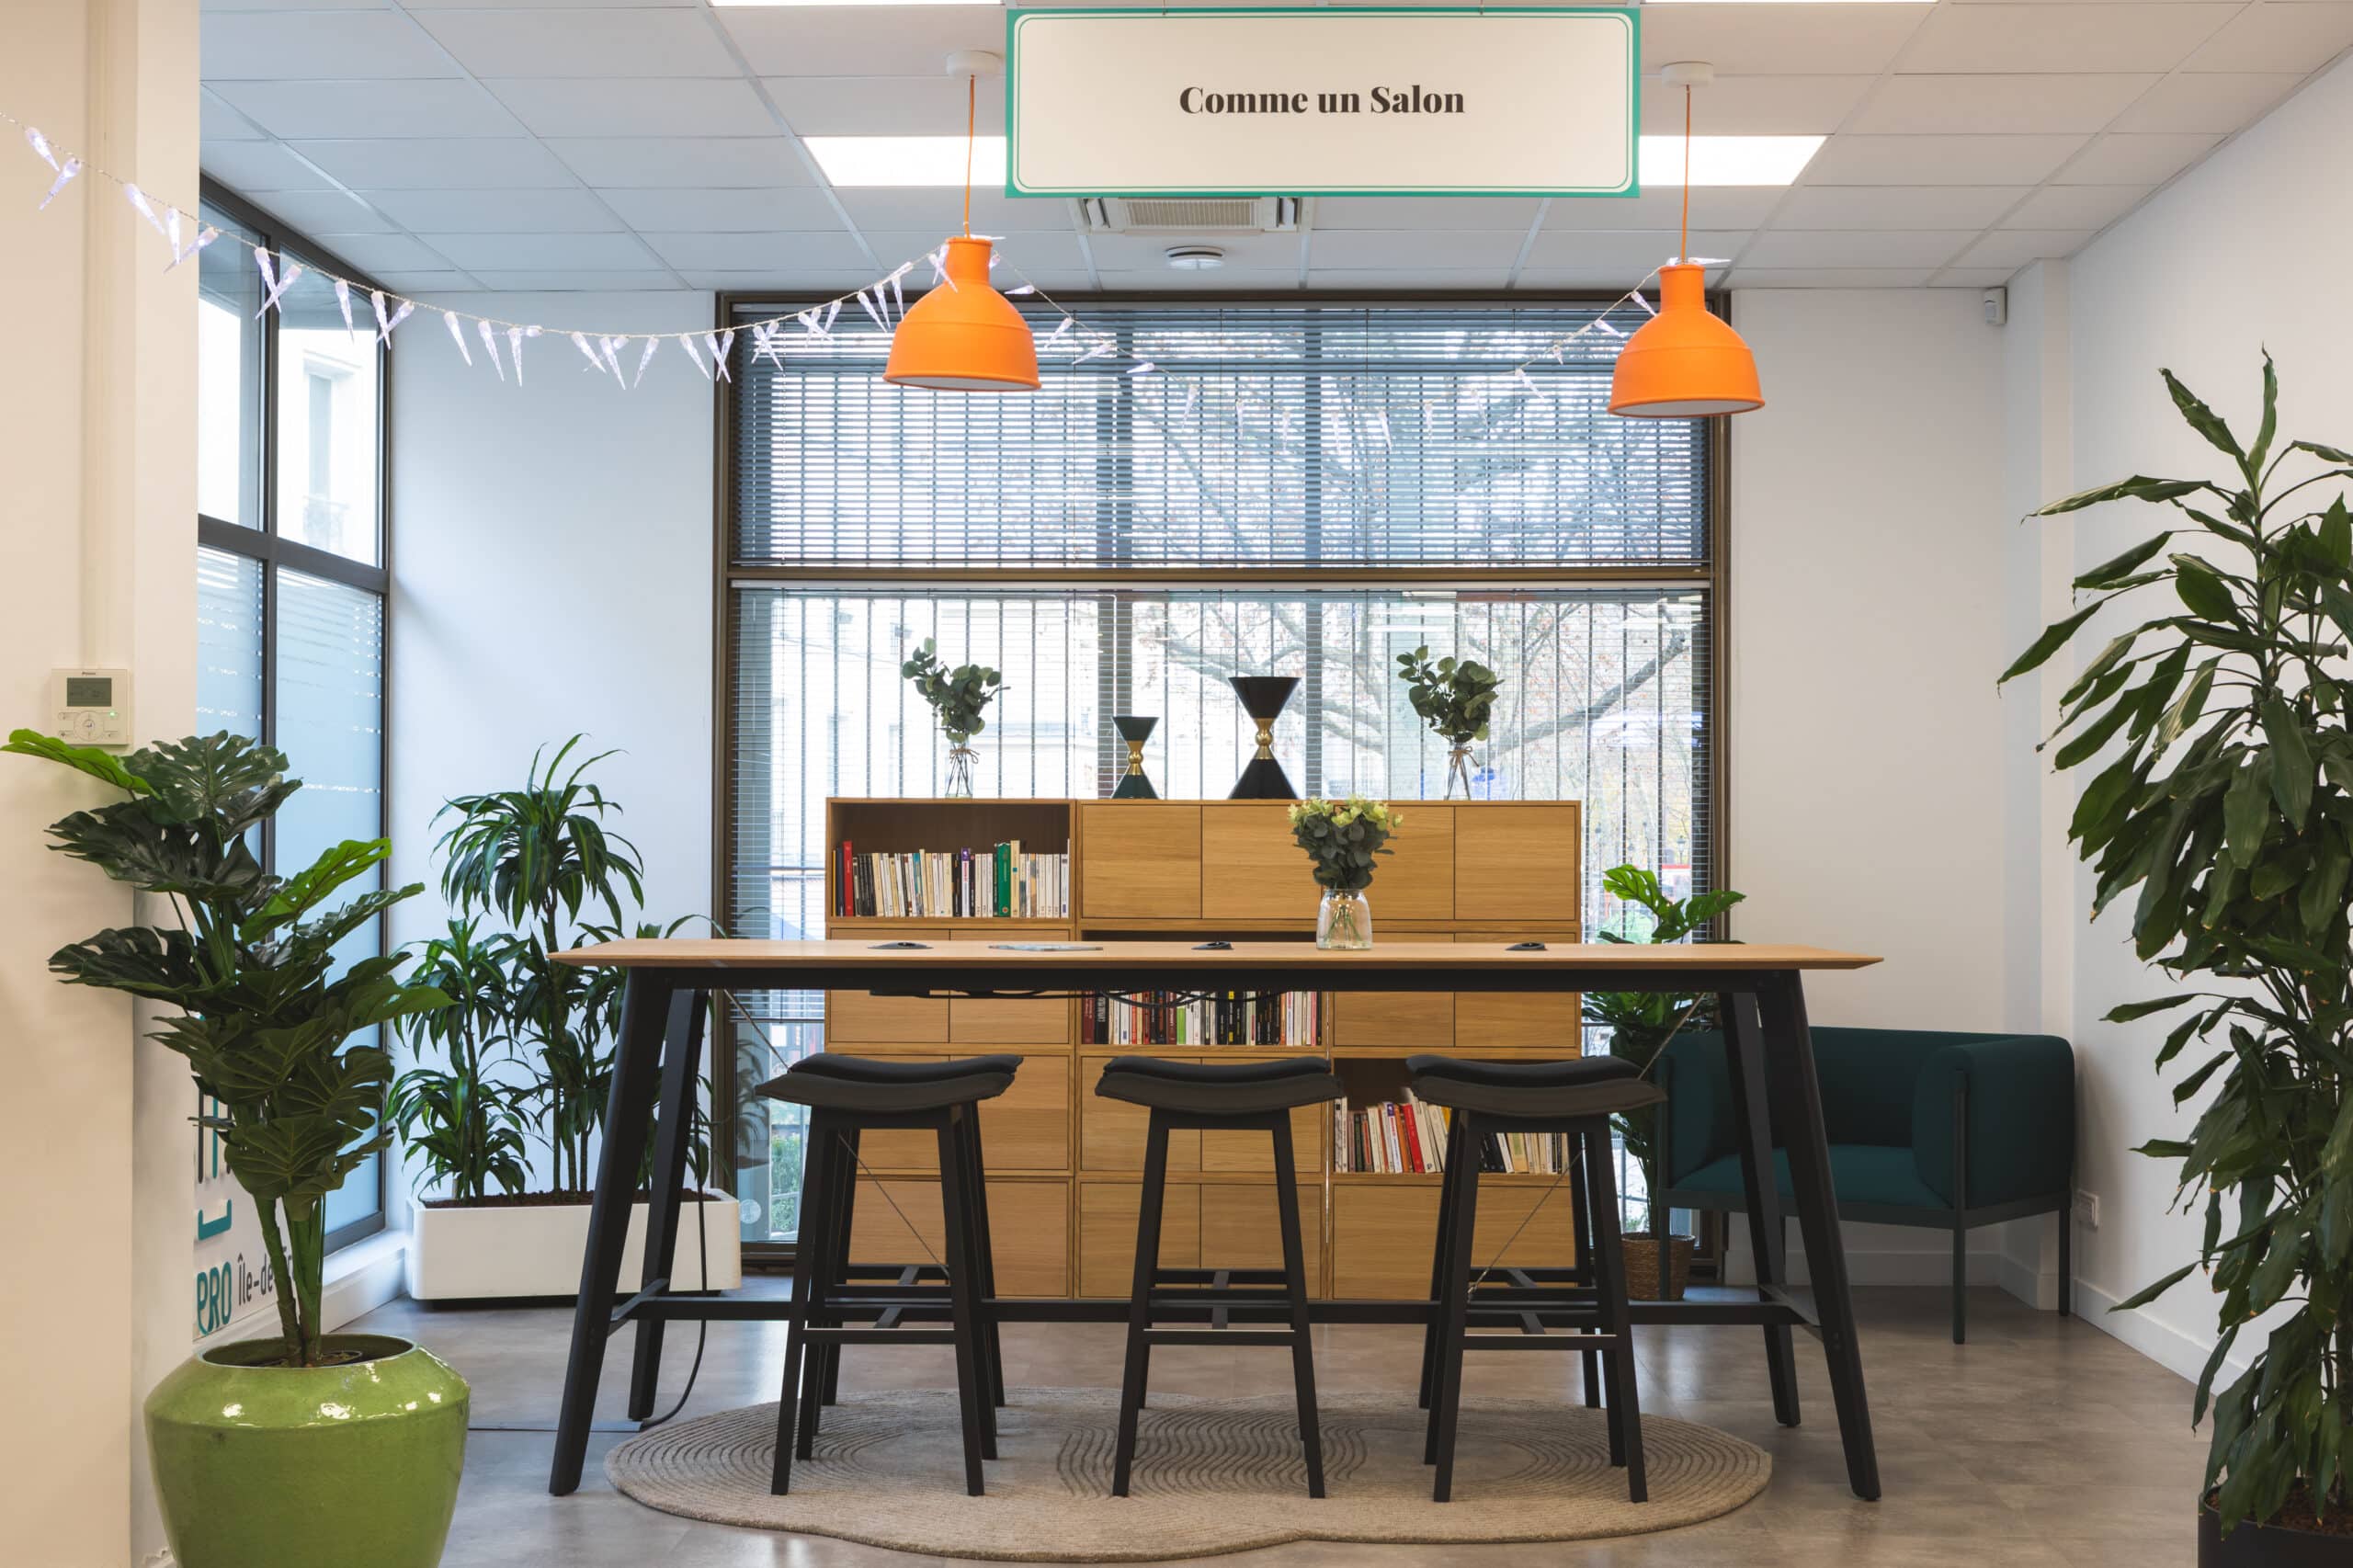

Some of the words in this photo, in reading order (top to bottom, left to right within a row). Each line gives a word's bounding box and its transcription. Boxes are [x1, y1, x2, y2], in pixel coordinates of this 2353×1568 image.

[1179, 86, 1309, 114] Comme
[1317, 93, 1361, 114] un
[1370, 85, 1465, 114] Salon
[238, 1252, 274, 1306] Île-de
